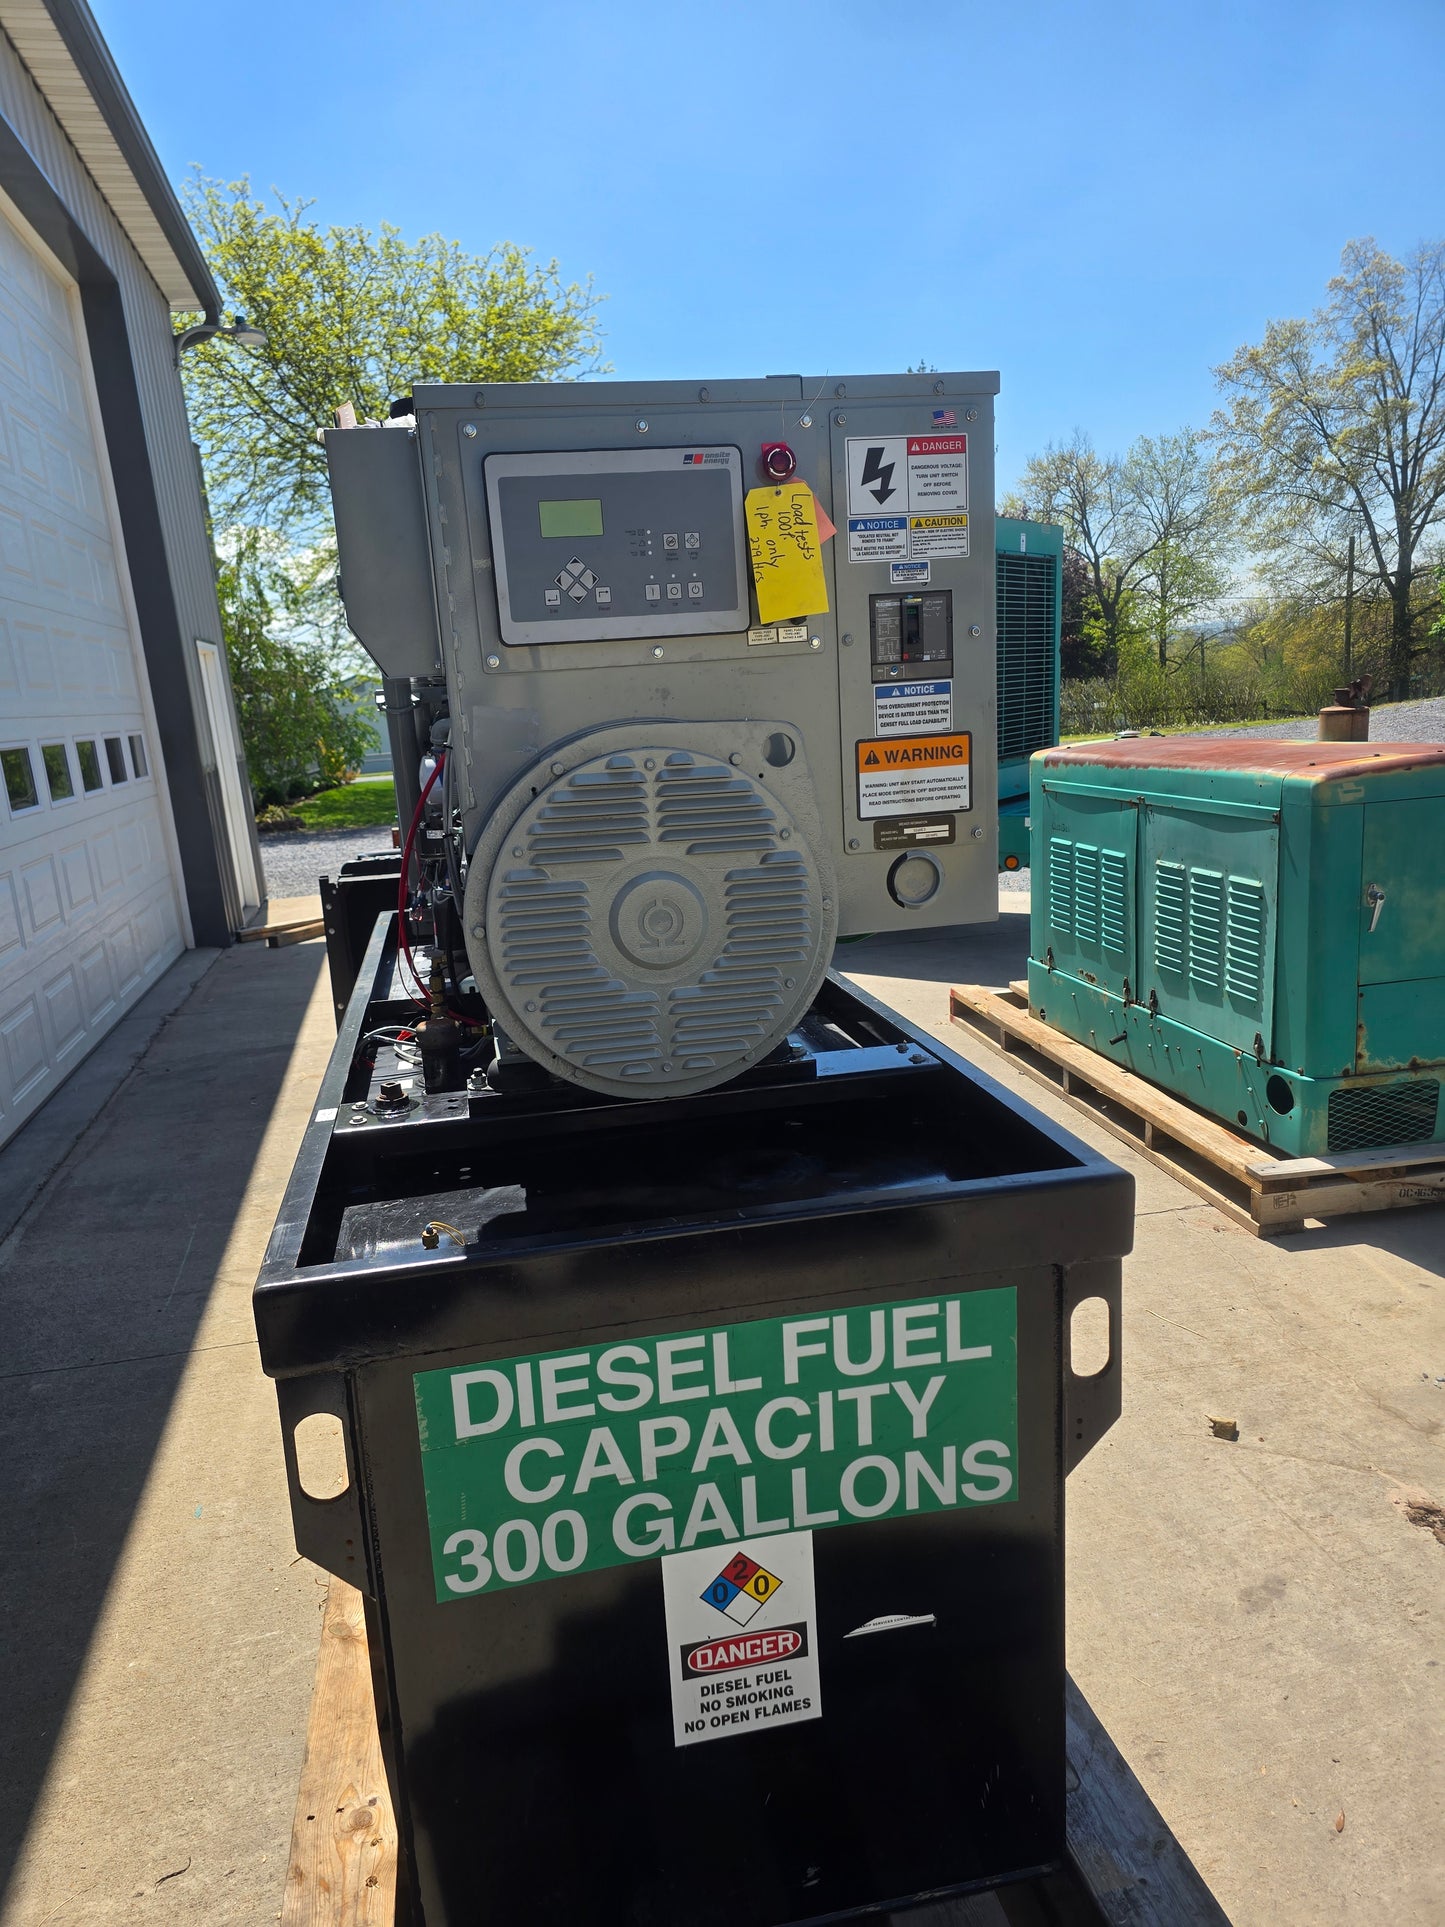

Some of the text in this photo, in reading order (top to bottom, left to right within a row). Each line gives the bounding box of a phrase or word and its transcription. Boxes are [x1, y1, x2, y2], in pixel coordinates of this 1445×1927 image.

[922, 440, 962, 451] DANGER
[790, 493, 815, 561] Load tests
[866, 520, 899, 530] NOTICE
[924, 517, 963, 527] CAUTION
[763, 539, 786, 568] only
[752, 561, 765, 584] Hrs
[904, 685, 935, 695] NOTICE
[888, 702, 921, 710] OVERCURRENT
[922, 717, 948, 725] CAPABILITY
[883, 744, 964, 764] WARNING
[926, 776, 964, 785] AUTOMATICALLY
[947, 784, 967, 792] SERVICE
[882, 797, 915, 806] INSTRUCTIONS
[450, 1300, 992, 1440] DIESEL FUEL
[504, 1375, 947, 1504] CAPACITY
[443, 1439, 1013, 1593] 300 GALLONS
[732, 1559, 749, 1581] 2
[712, 1574, 770, 1604] 0 0
[696, 1632, 794, 1669] DANGER
[700, 1669, 792, 1698] DIESEL FUEL
[700, 1685, 794, 1714] NO SMOKING
[684, 1697, 811, 1734] NO OPEN FLAMES
